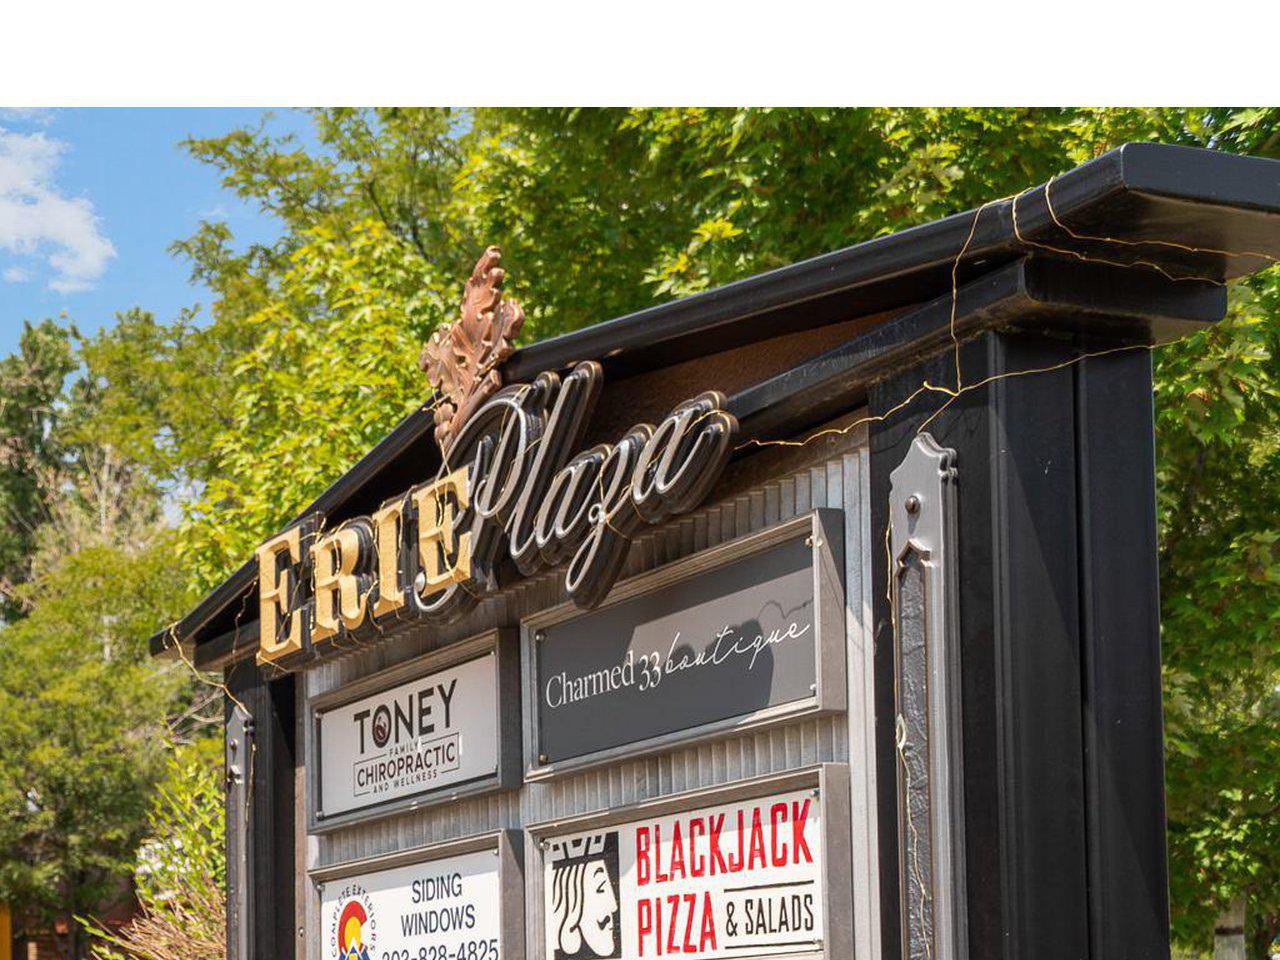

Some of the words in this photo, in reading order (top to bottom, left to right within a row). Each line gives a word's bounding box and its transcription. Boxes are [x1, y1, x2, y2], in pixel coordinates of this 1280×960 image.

[256, 464, 474, 668] ERIE
[414, 360, 740, 612] Plaza
[546, 650, 635, 709] Charmed
[639, 651, 661, 692] 33
[665, 622, 811, 674] boutique
[354, 678, 458, 755] TONEY
[357, 742, 456, 788] CHIROPRACTIC
[389, 742, 420, 757] FAMILY
[373, 782, 390, 794] AND
[394, 769, 438, 788] WELLNESS
[636, 798, 813, 886] BLACKJACK
[411, 872, 463, 904] SIDING
[400, 904, 476, 938] WINDOWS
[637, 891, 718, 957] PIZZA
[725, 901, 738, 937] &
[744, 893, 814, 935] SALADS
